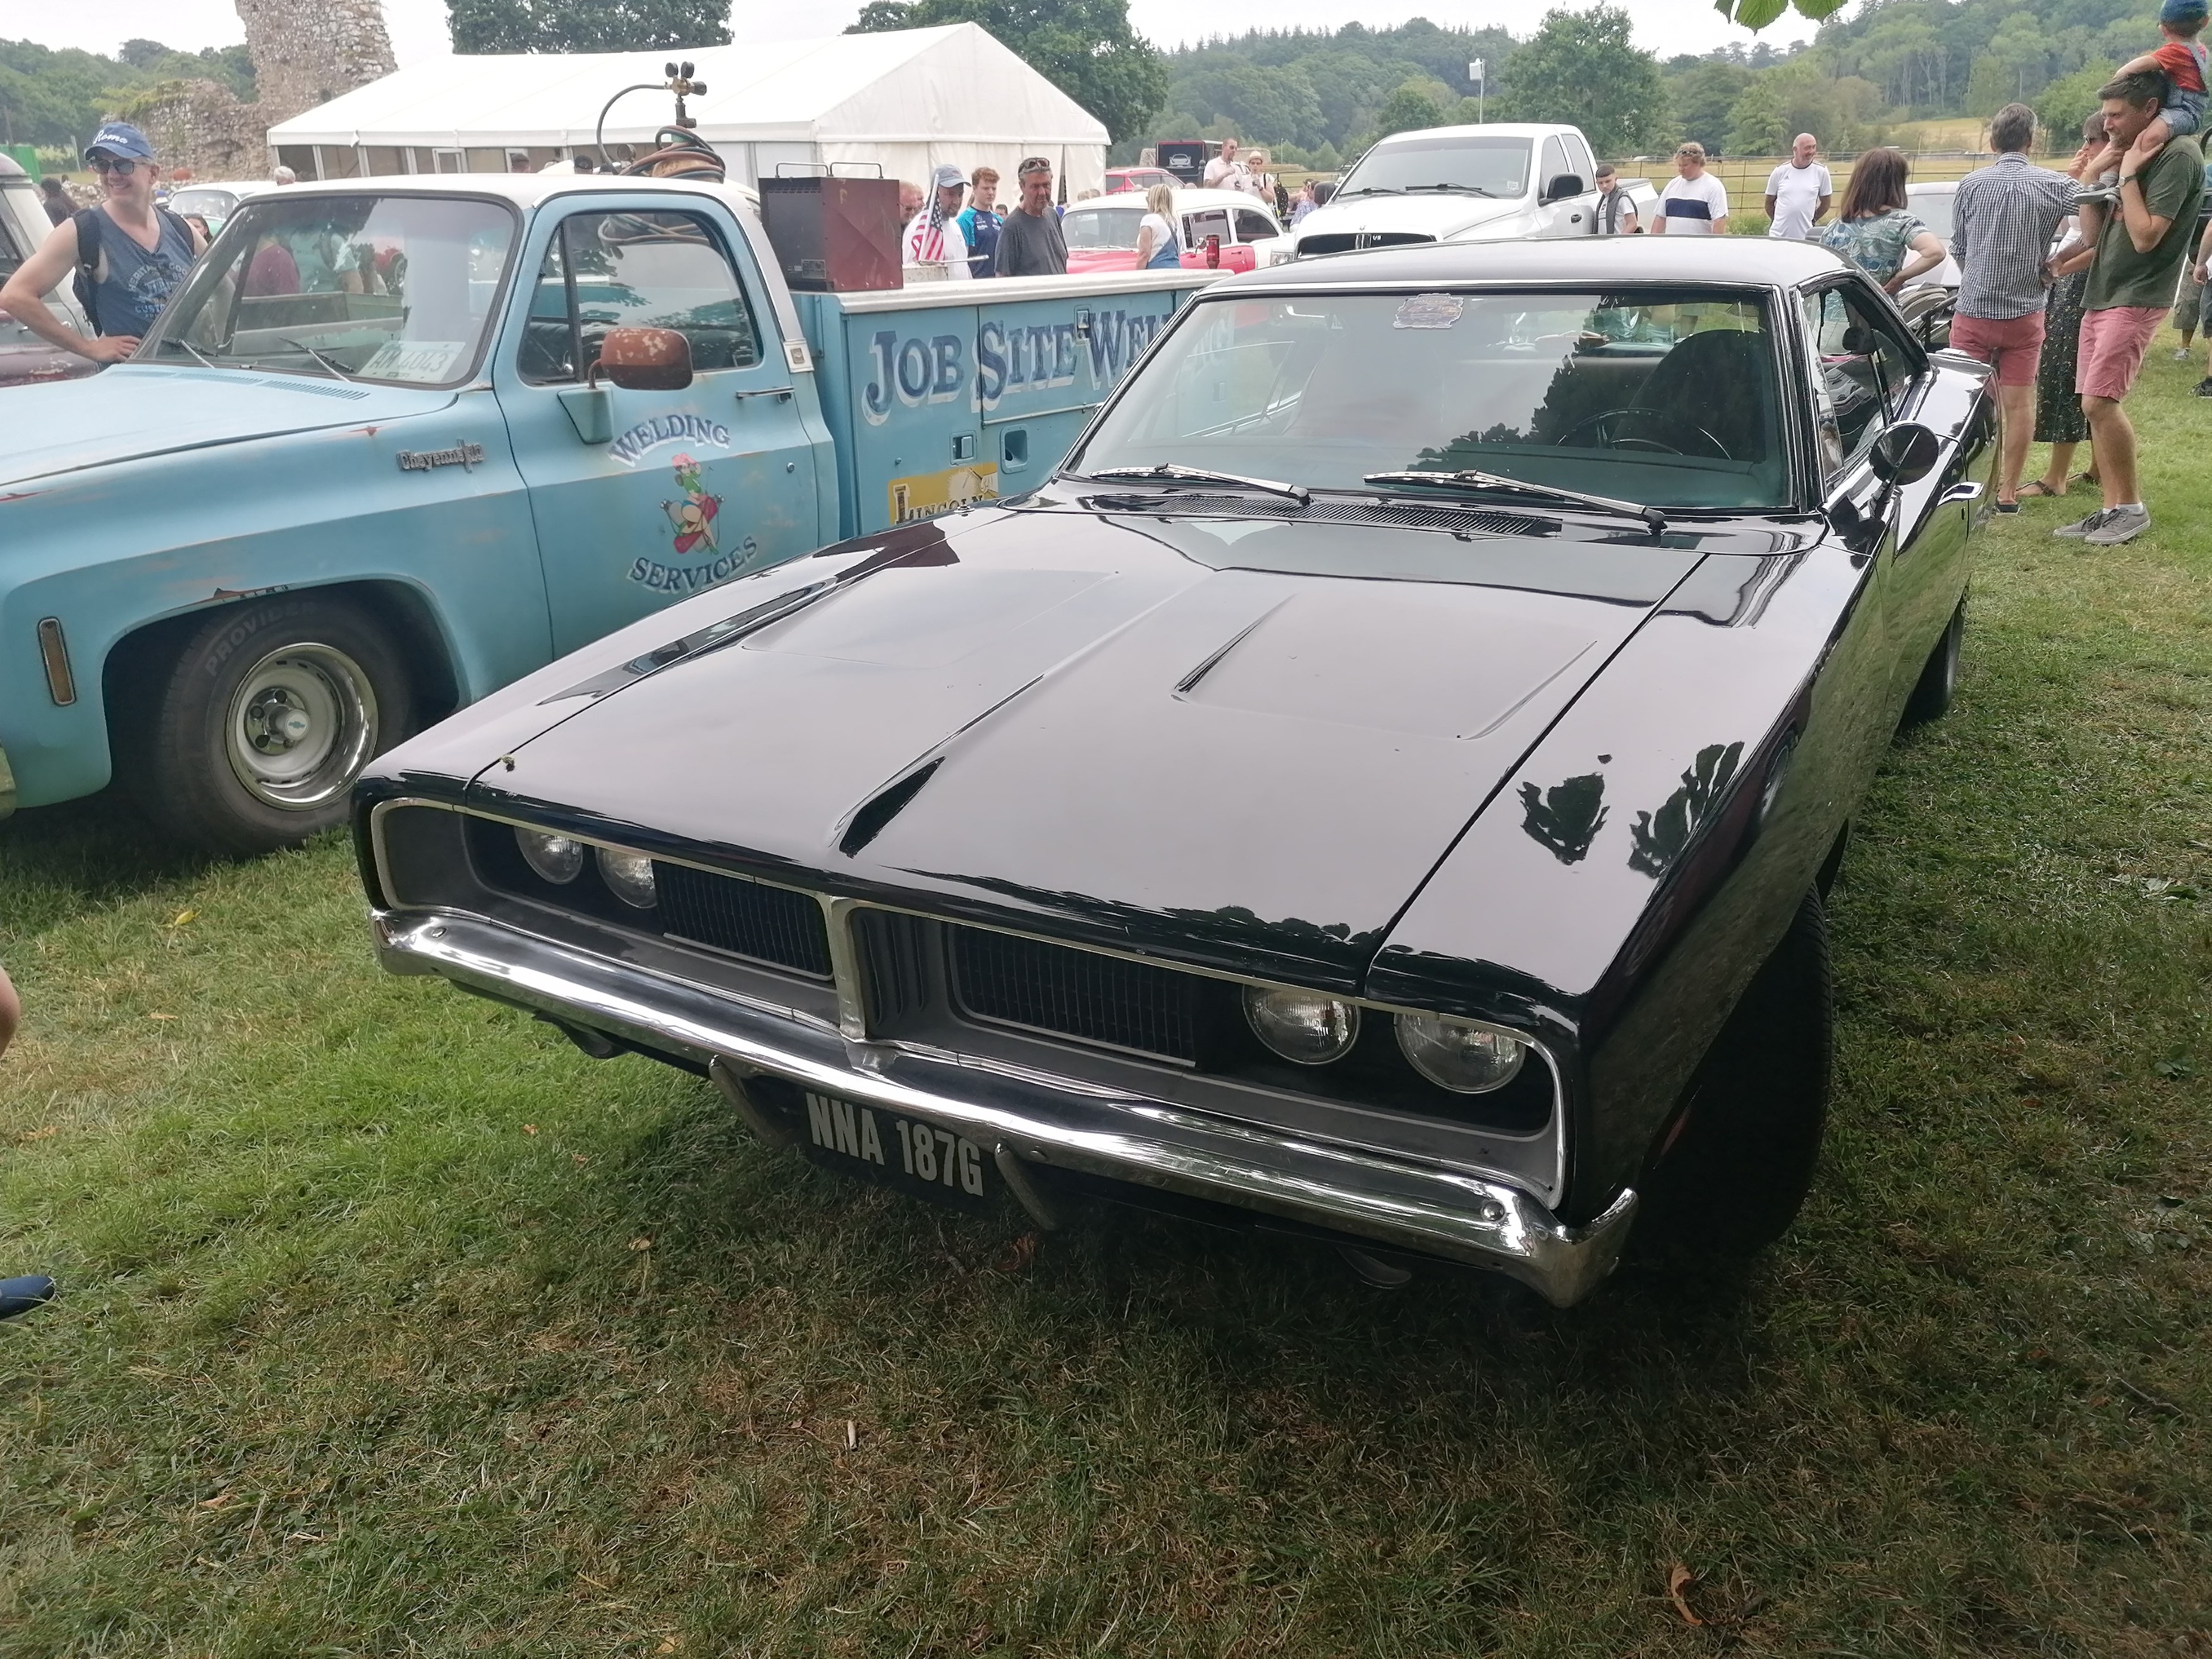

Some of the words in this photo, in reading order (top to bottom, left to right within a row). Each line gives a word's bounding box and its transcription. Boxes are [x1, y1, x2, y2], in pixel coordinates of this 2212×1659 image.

[368, 348, 403, 369] AM
[398, 351, 449, 373] 4043
[862, 329, 965, 425] JOB
[971, 320, 1078, 413] SITE
[398, 447, 465, 472] Cheyenne
[607, 413, 731, 468] WELDING
[626, 535, 758, 594] SERVICES
[805, 1092, 885, 1166] NNA
[896, 1119, 984, 1197] 187G
